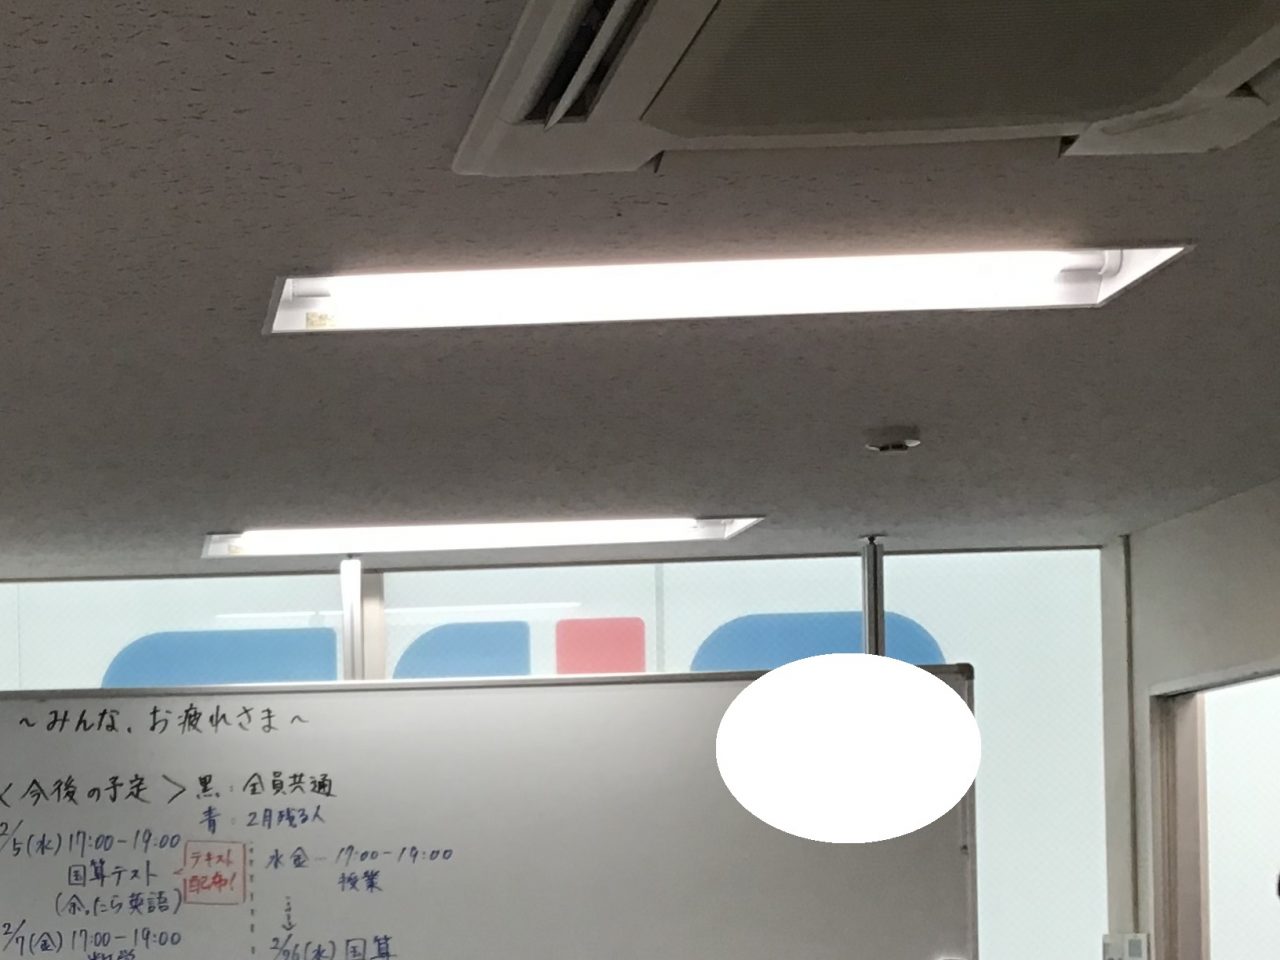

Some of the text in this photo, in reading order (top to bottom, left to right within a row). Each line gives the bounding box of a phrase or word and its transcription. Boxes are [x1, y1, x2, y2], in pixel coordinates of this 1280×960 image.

[68, 859, 158, 887] 国算テスト
[337, 870, 383, 894] 授業
